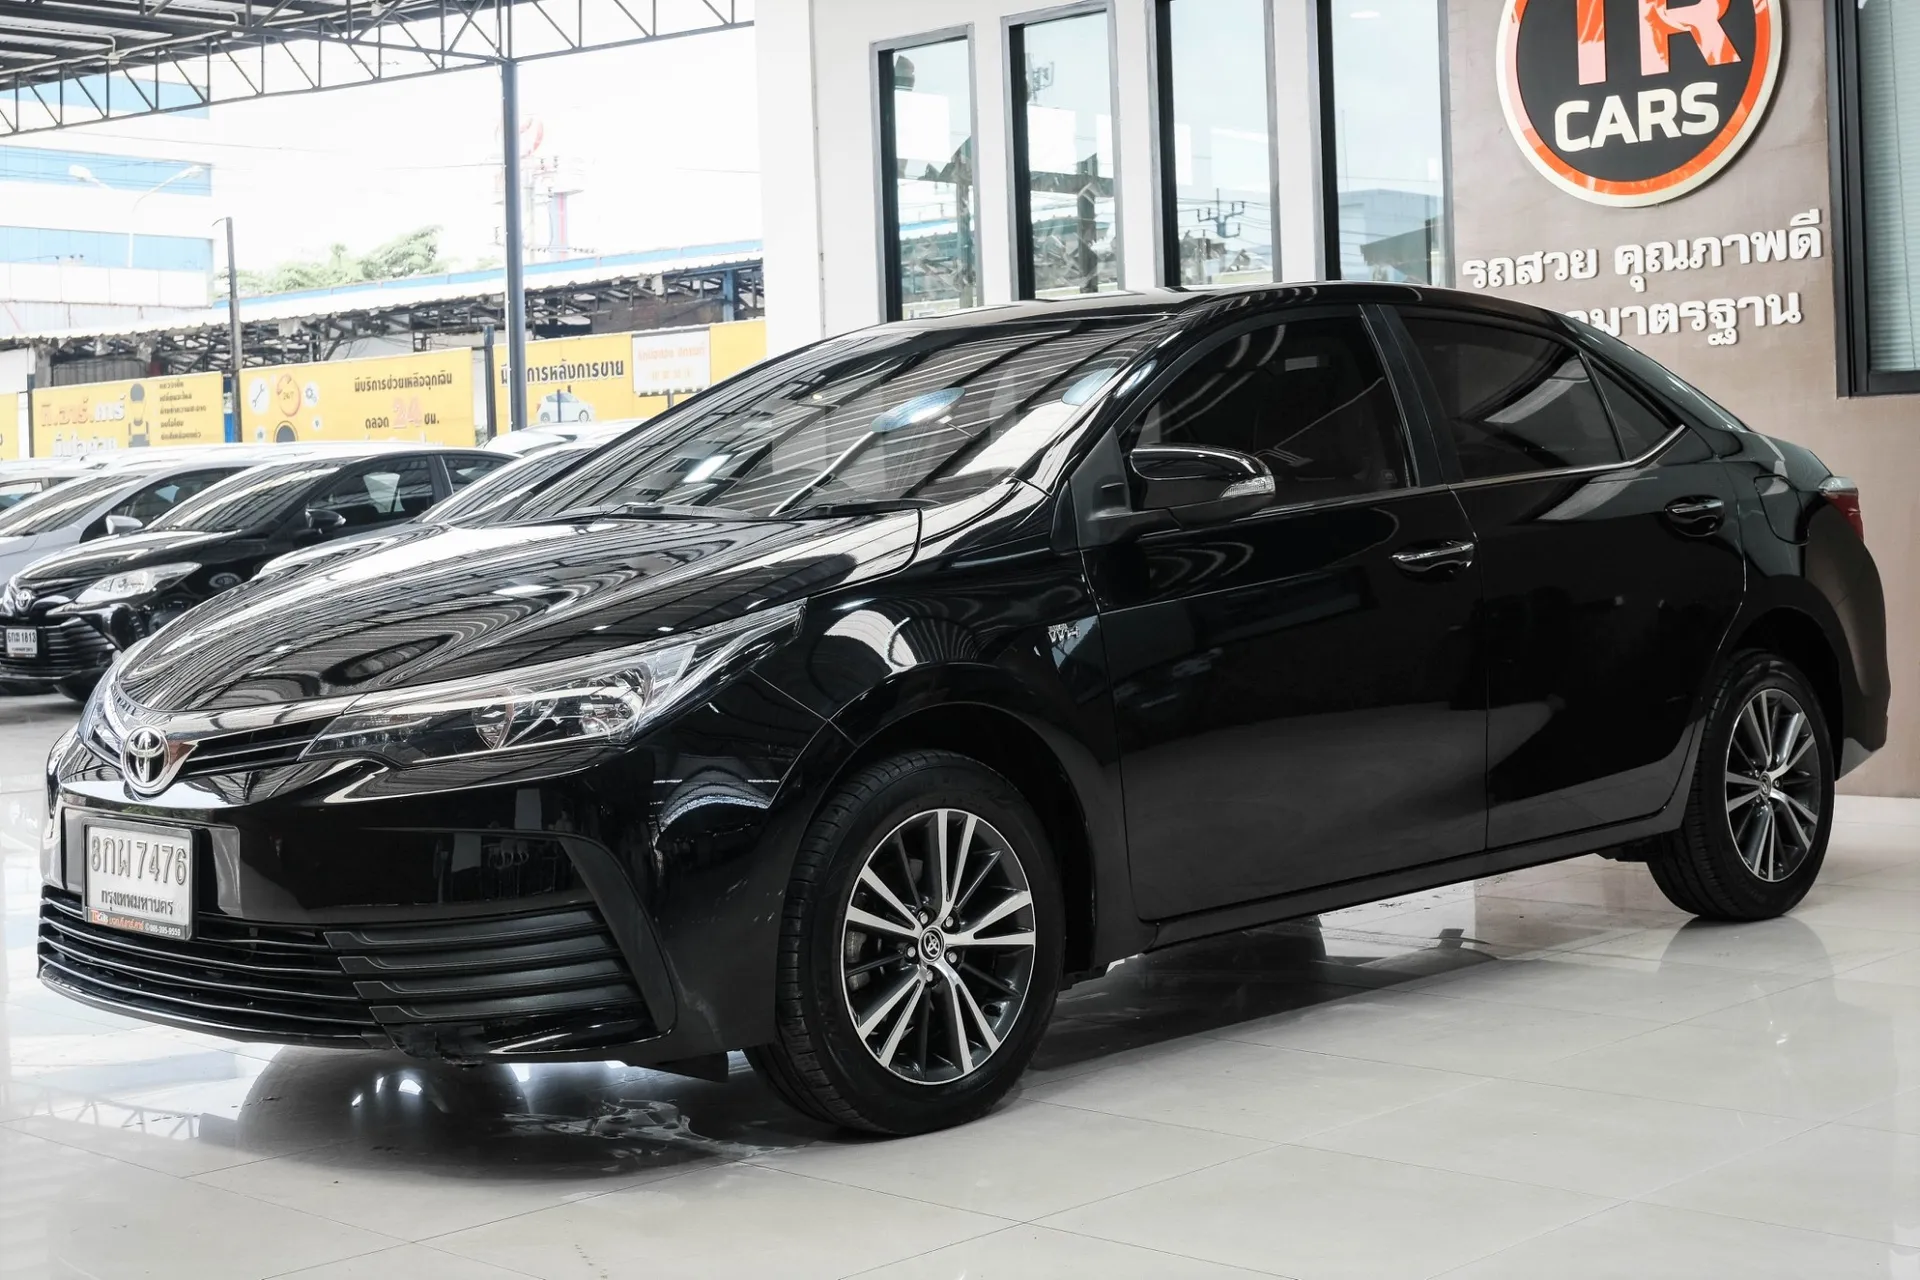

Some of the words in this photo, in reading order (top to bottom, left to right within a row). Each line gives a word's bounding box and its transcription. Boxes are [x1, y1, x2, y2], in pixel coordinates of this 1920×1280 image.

[1553, 82, 1720, 153] CARS
[1462, 247, 1599, 289] รถสวย
[1614, 208, 1823, 293] คุณภาพดี
[365, 416, 390, 429] ตลอด
[392, 396, 423, 429] 24
[424, 413, 440, 425] ชม.
[90, 835, 132, 878] 8กผ
[136, 841, 187, 886] 7476
[101, 889, 174, 915] กรุงเทพมหานคร
